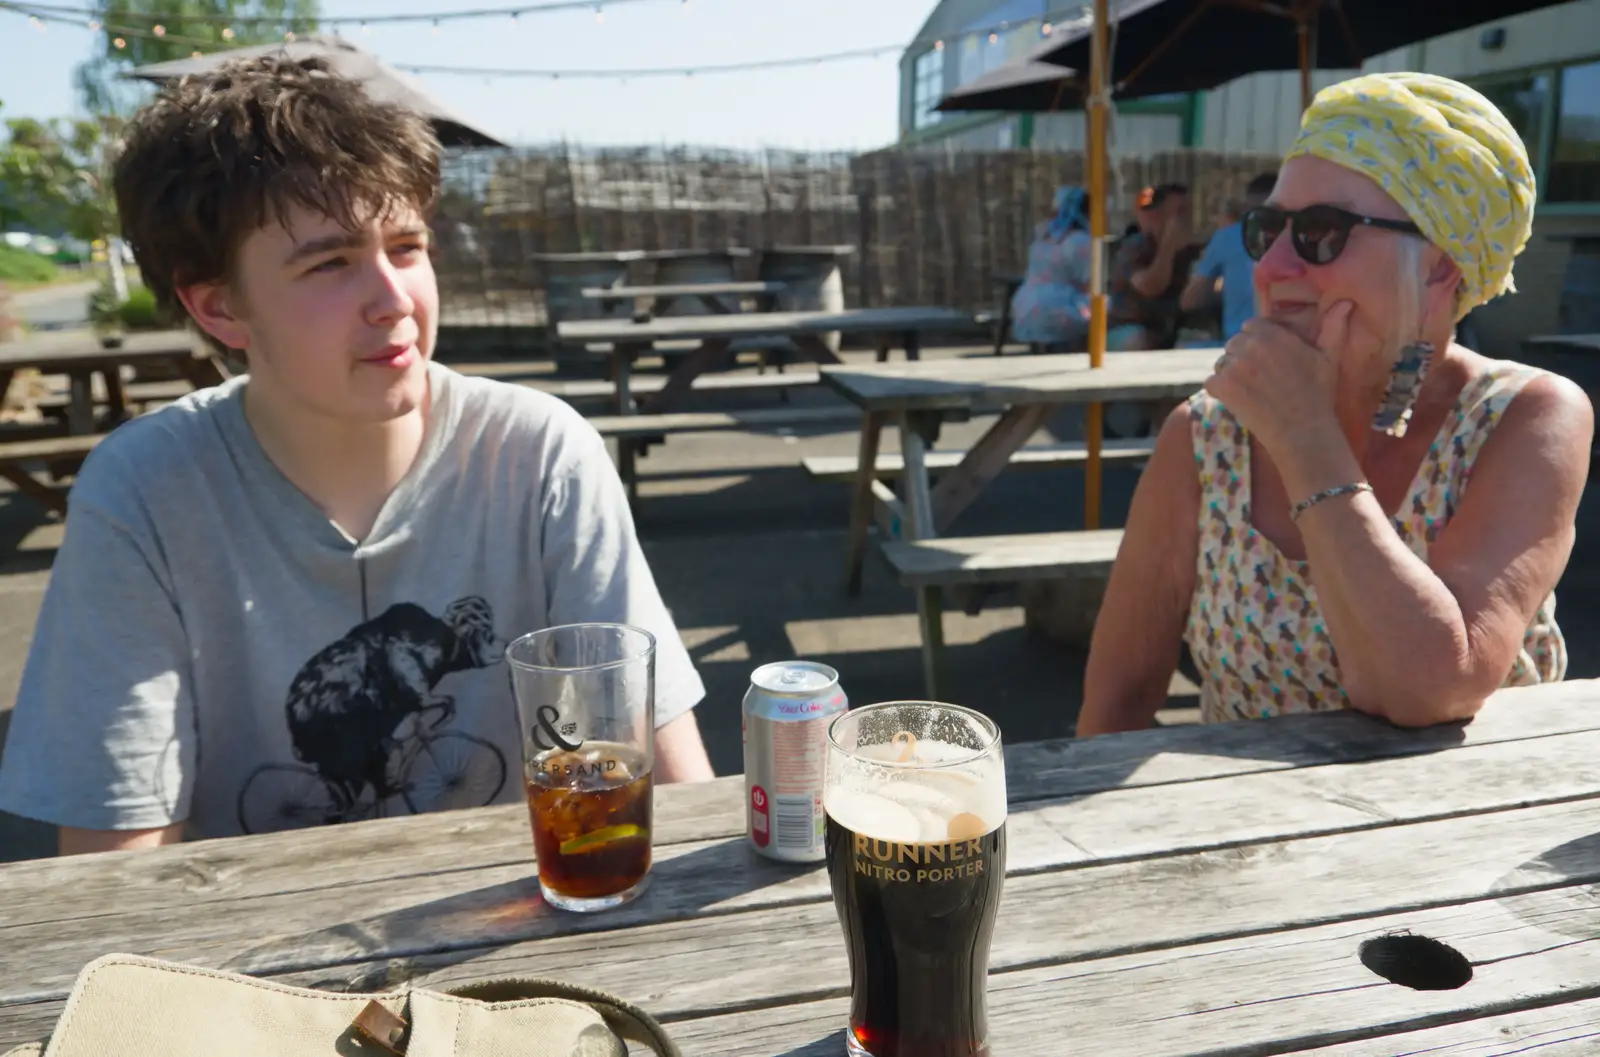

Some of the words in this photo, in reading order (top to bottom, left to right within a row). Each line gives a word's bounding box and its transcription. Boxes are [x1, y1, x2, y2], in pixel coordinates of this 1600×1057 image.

[531, 705, 583, 751] &
[855, 832, 983, 864] RUNNER
[855, 859, 911, 882] NITRO
[917, 859, 984, 883] PORTER
